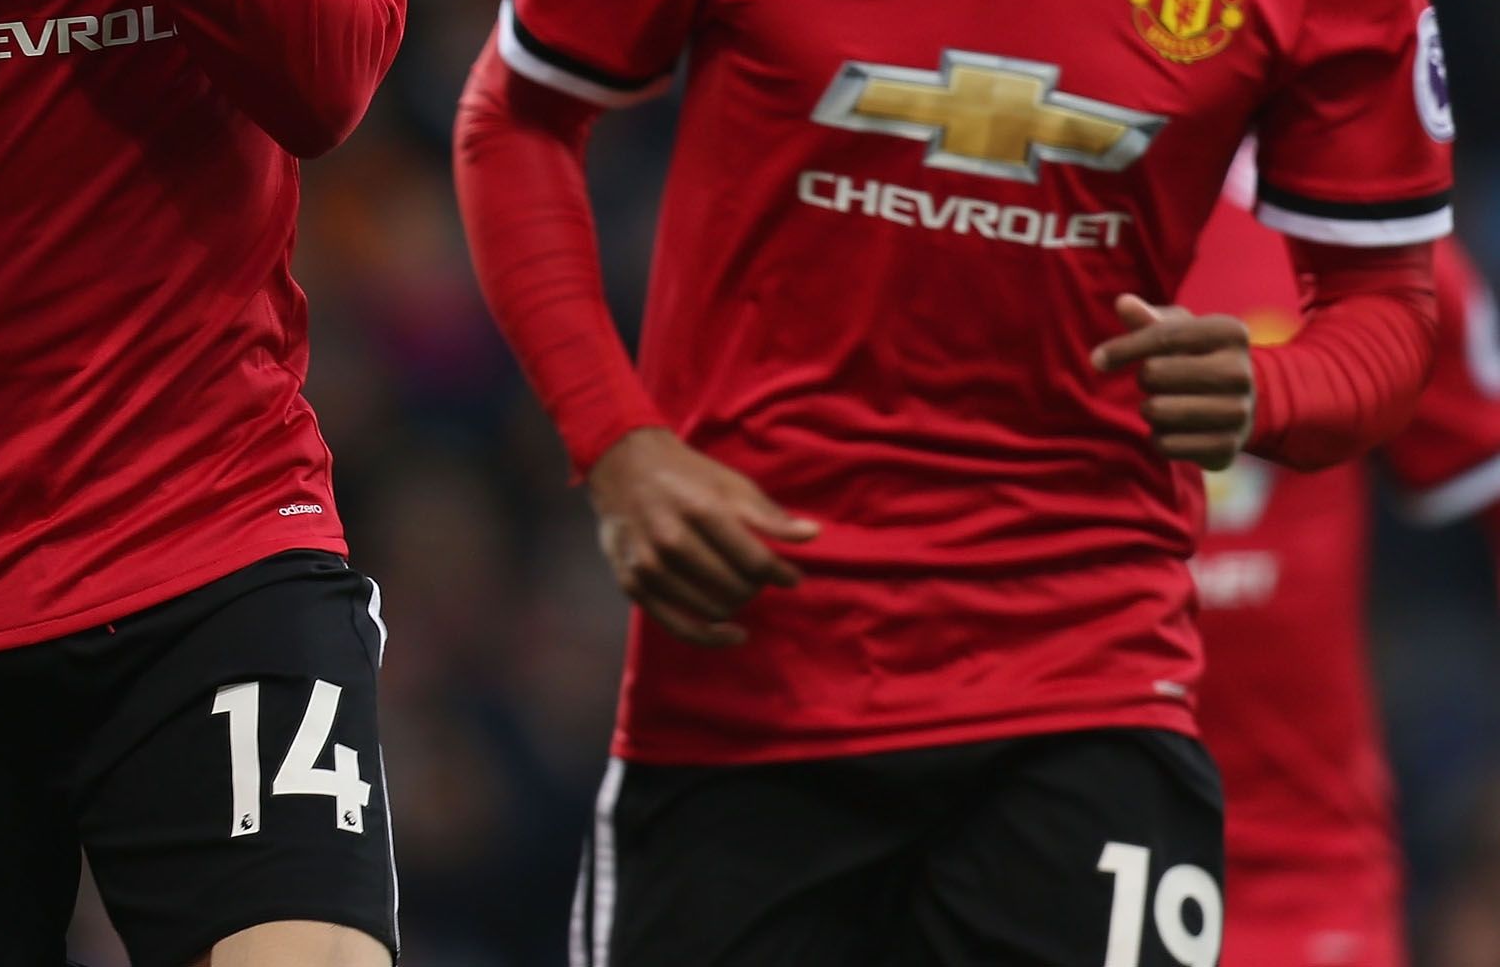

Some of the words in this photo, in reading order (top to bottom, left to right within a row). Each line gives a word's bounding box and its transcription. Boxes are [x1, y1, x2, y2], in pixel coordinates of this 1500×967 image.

[798, 170, 1132, 249] CHEVROLET
[279, 504, 322, 516] adizero
[211, 679, 372, 838] 14
[1096, 841, 1224, 967] 19
